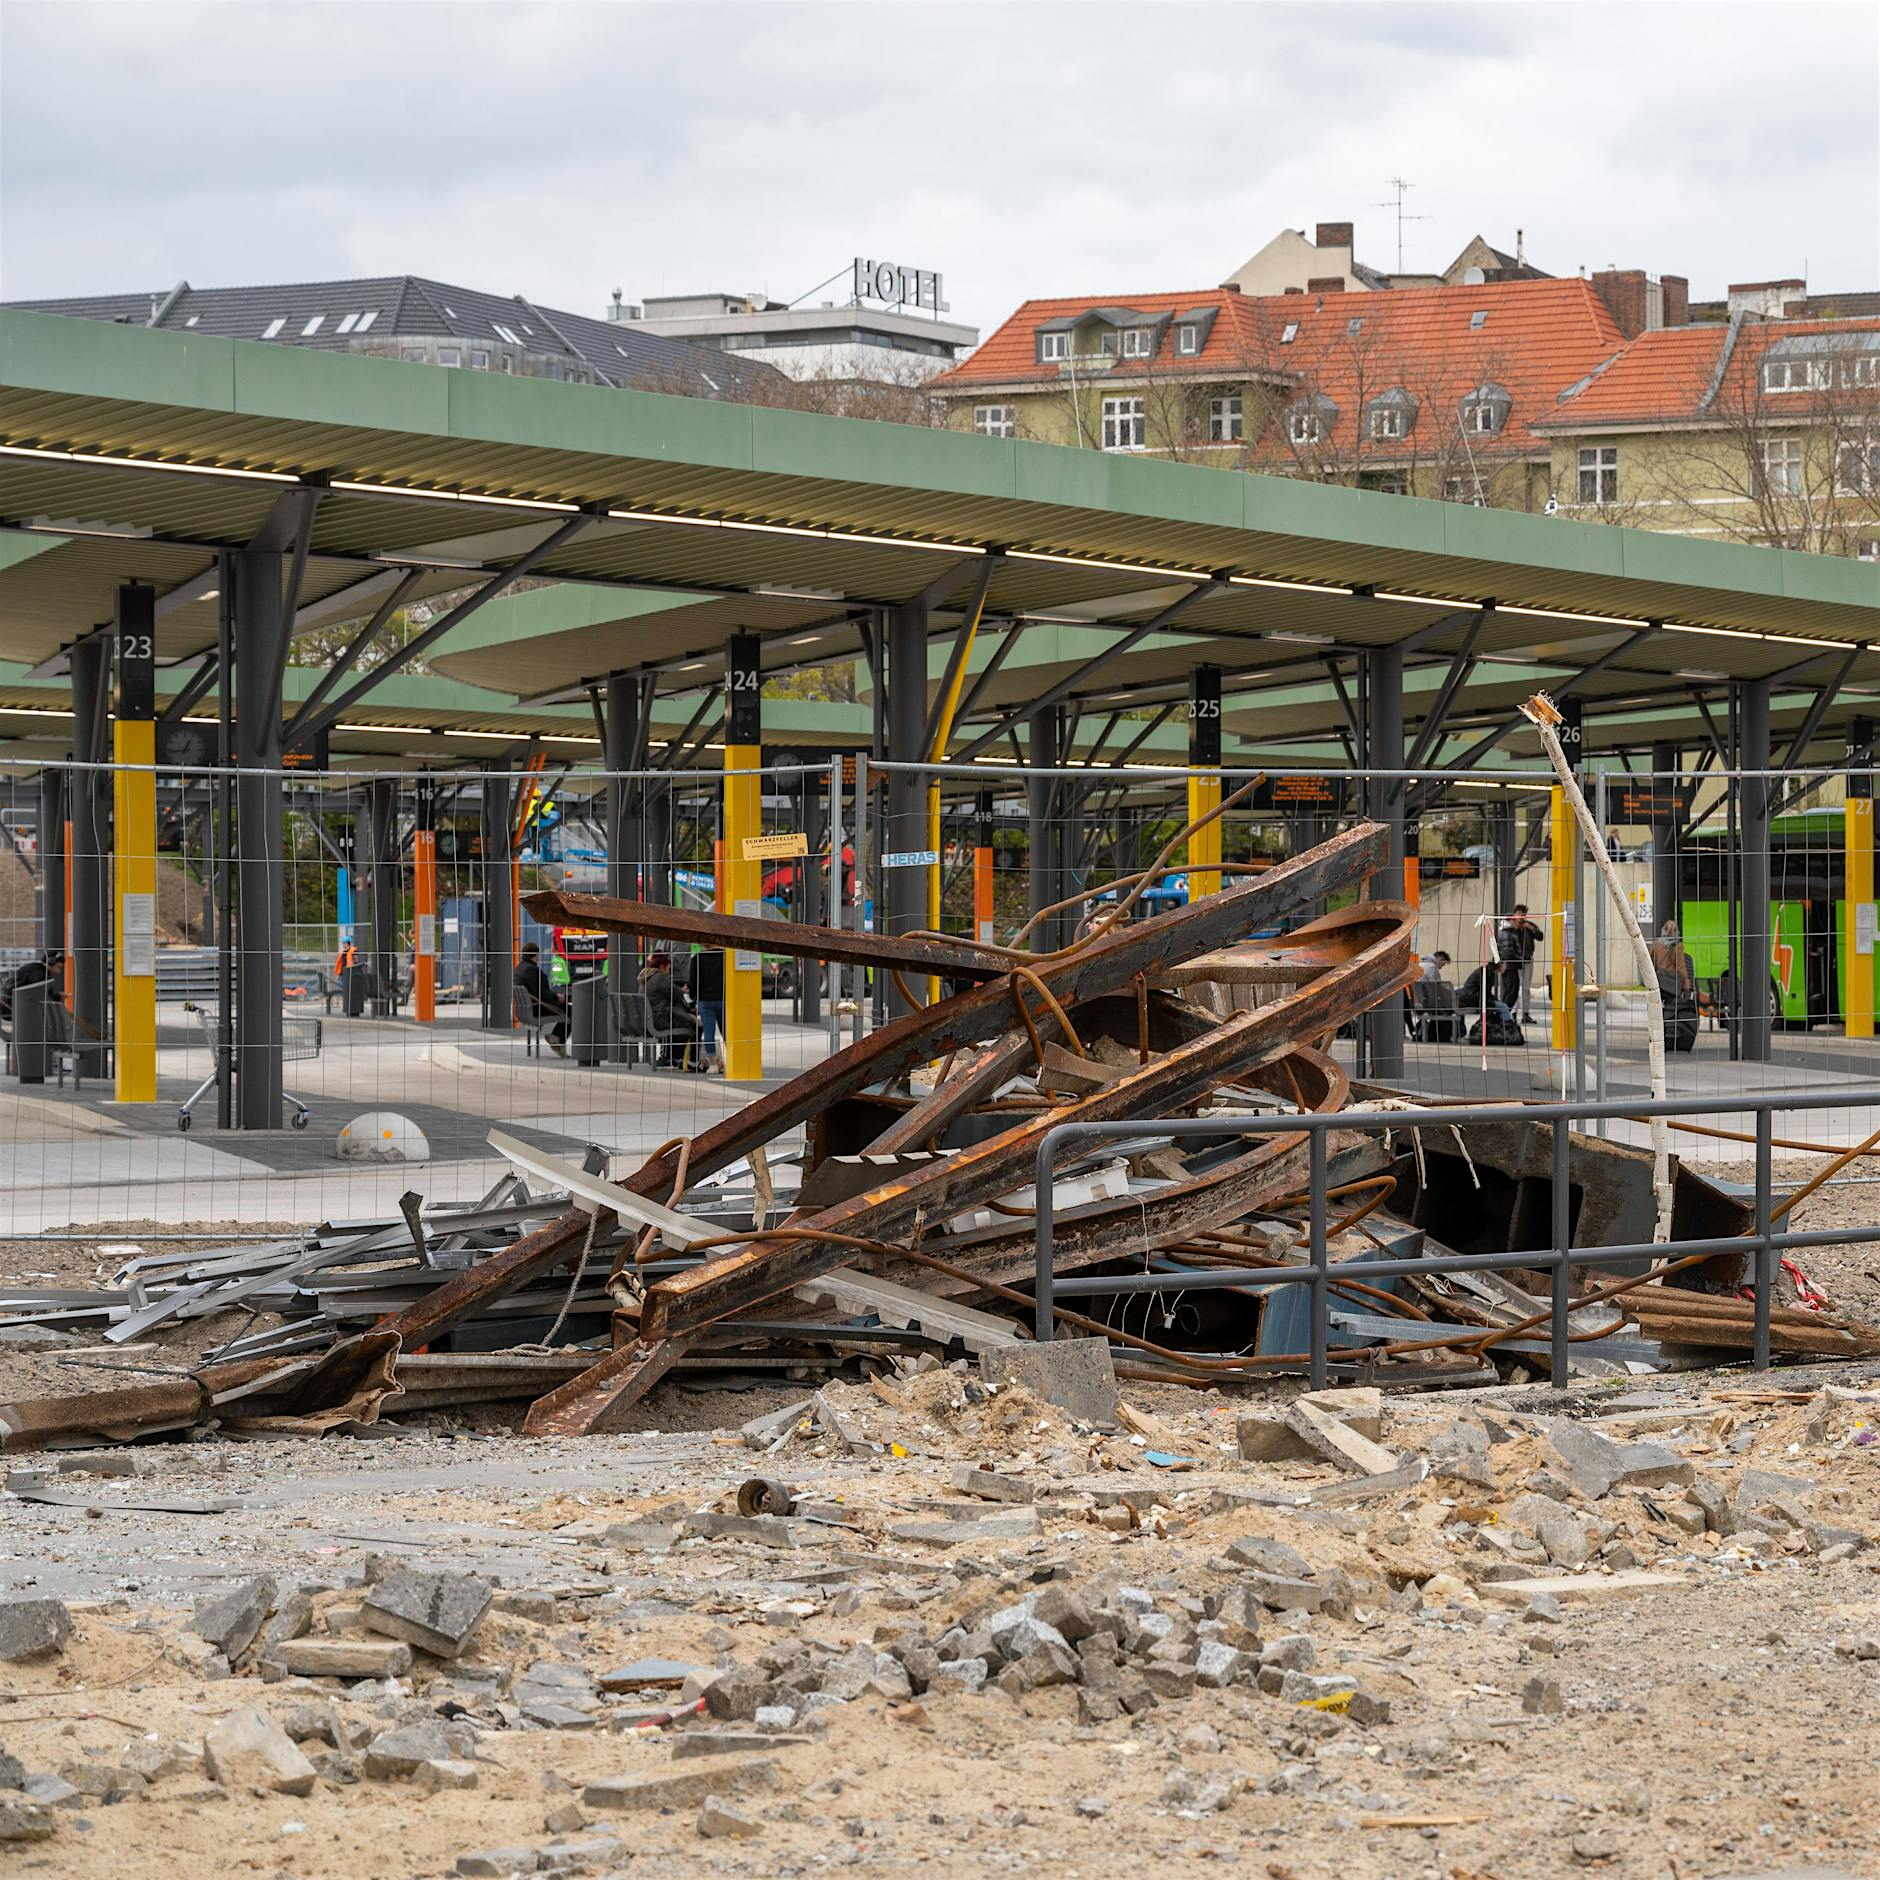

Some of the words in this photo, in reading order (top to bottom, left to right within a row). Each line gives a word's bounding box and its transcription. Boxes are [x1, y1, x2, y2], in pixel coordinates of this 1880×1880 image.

[854, 257, 950, 312] HOTEL
[123, 635, 152, 659] 23
[733, 670, 759, 691] 24
[1198, 700, 1220, 718] 25
[1561, 726, 1581, 743] 26
[420, 787, 434, 801] 16
[1856, 799, 1873, 815] 27
[745, 835, 799, 845] SCHWARZFELLER
[887, 851, 937, 866] HERAS
